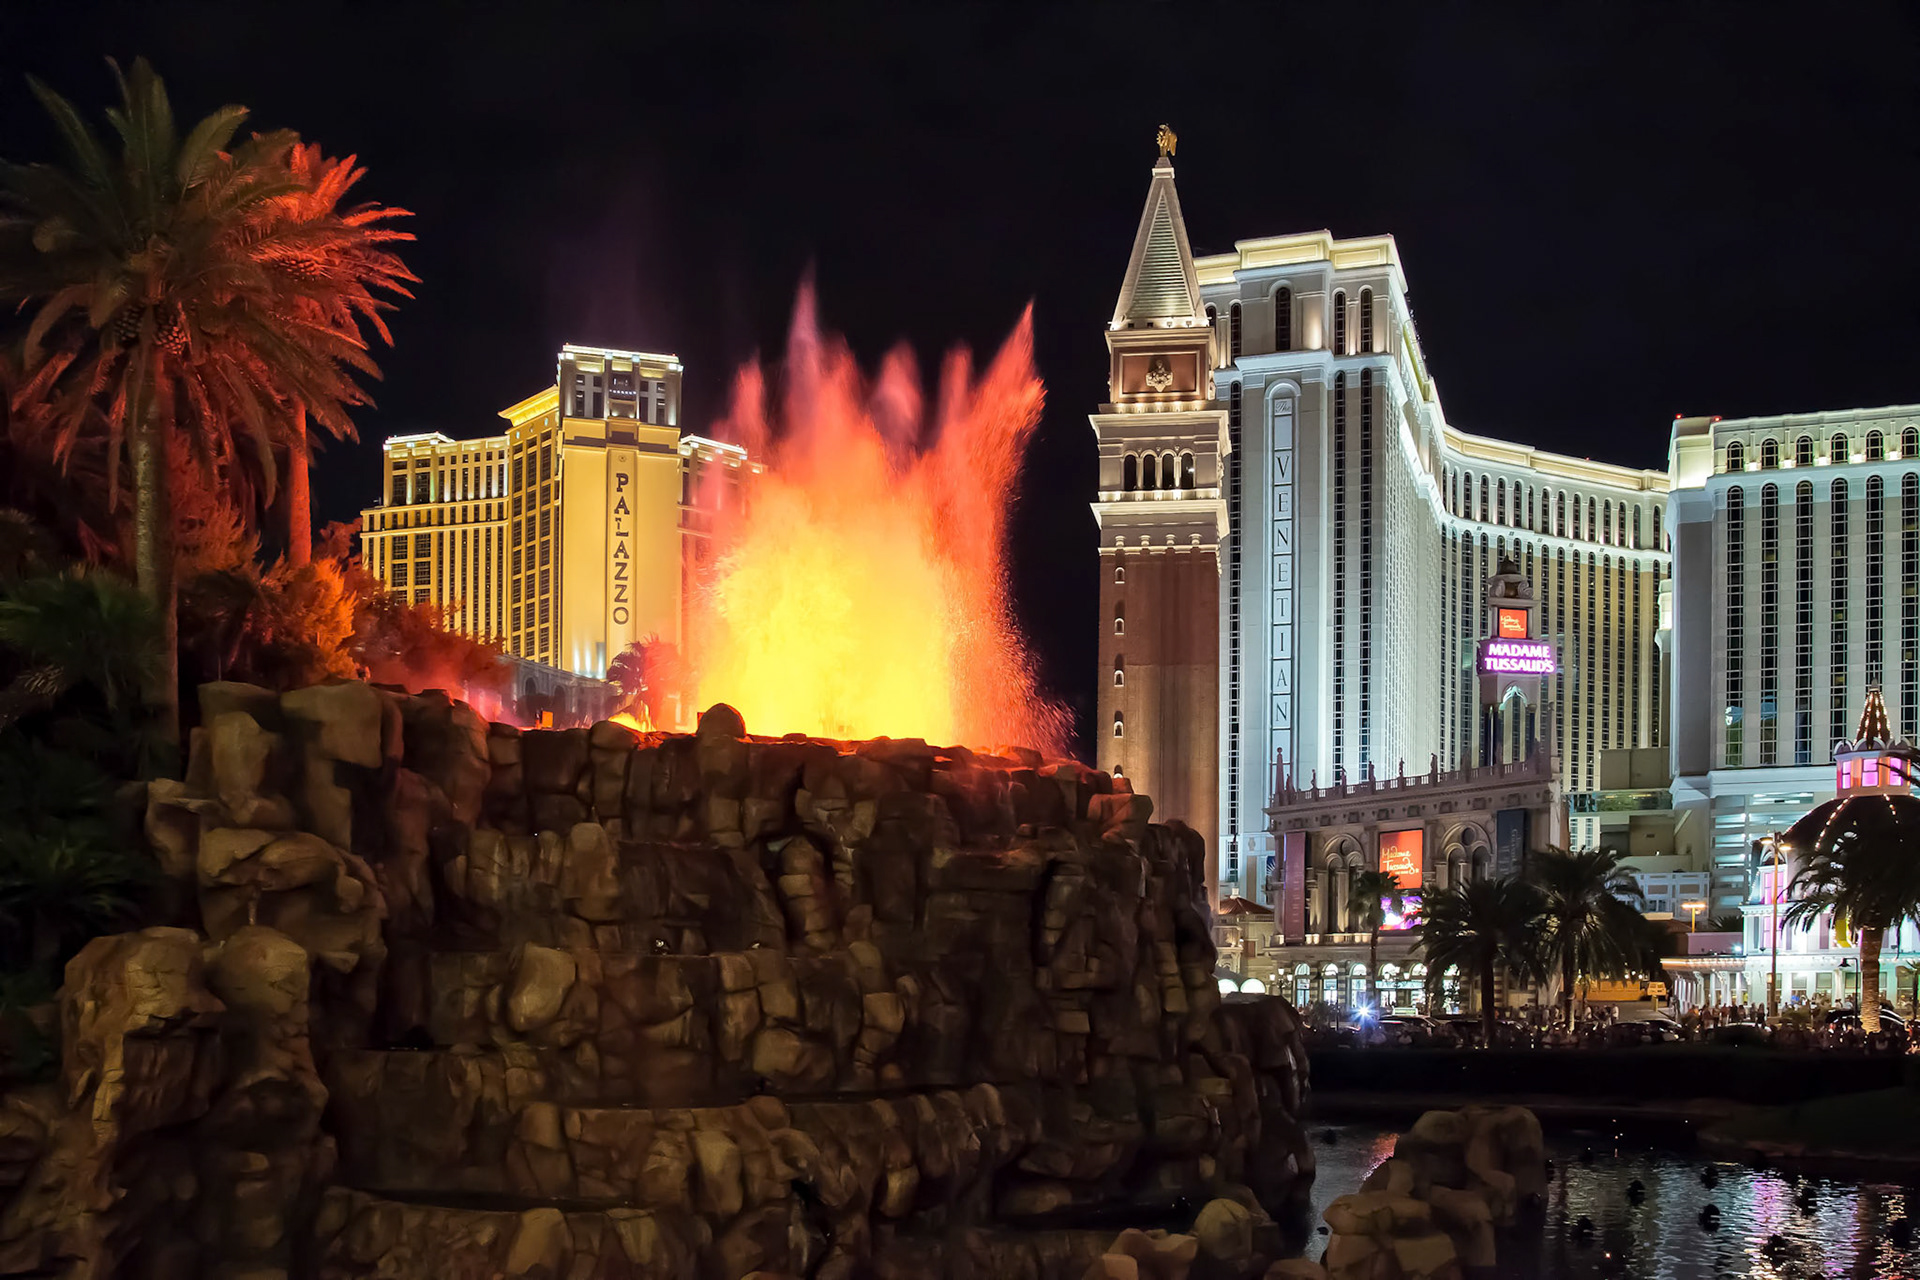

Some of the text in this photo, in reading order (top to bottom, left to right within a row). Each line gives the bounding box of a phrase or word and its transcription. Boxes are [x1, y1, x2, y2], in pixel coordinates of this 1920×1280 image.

[613, 473, 630, 625] PALAZZO
[1275, 455, 1291, 722] VENETIAN
[1488, 643, 1551, 658] MADAME
